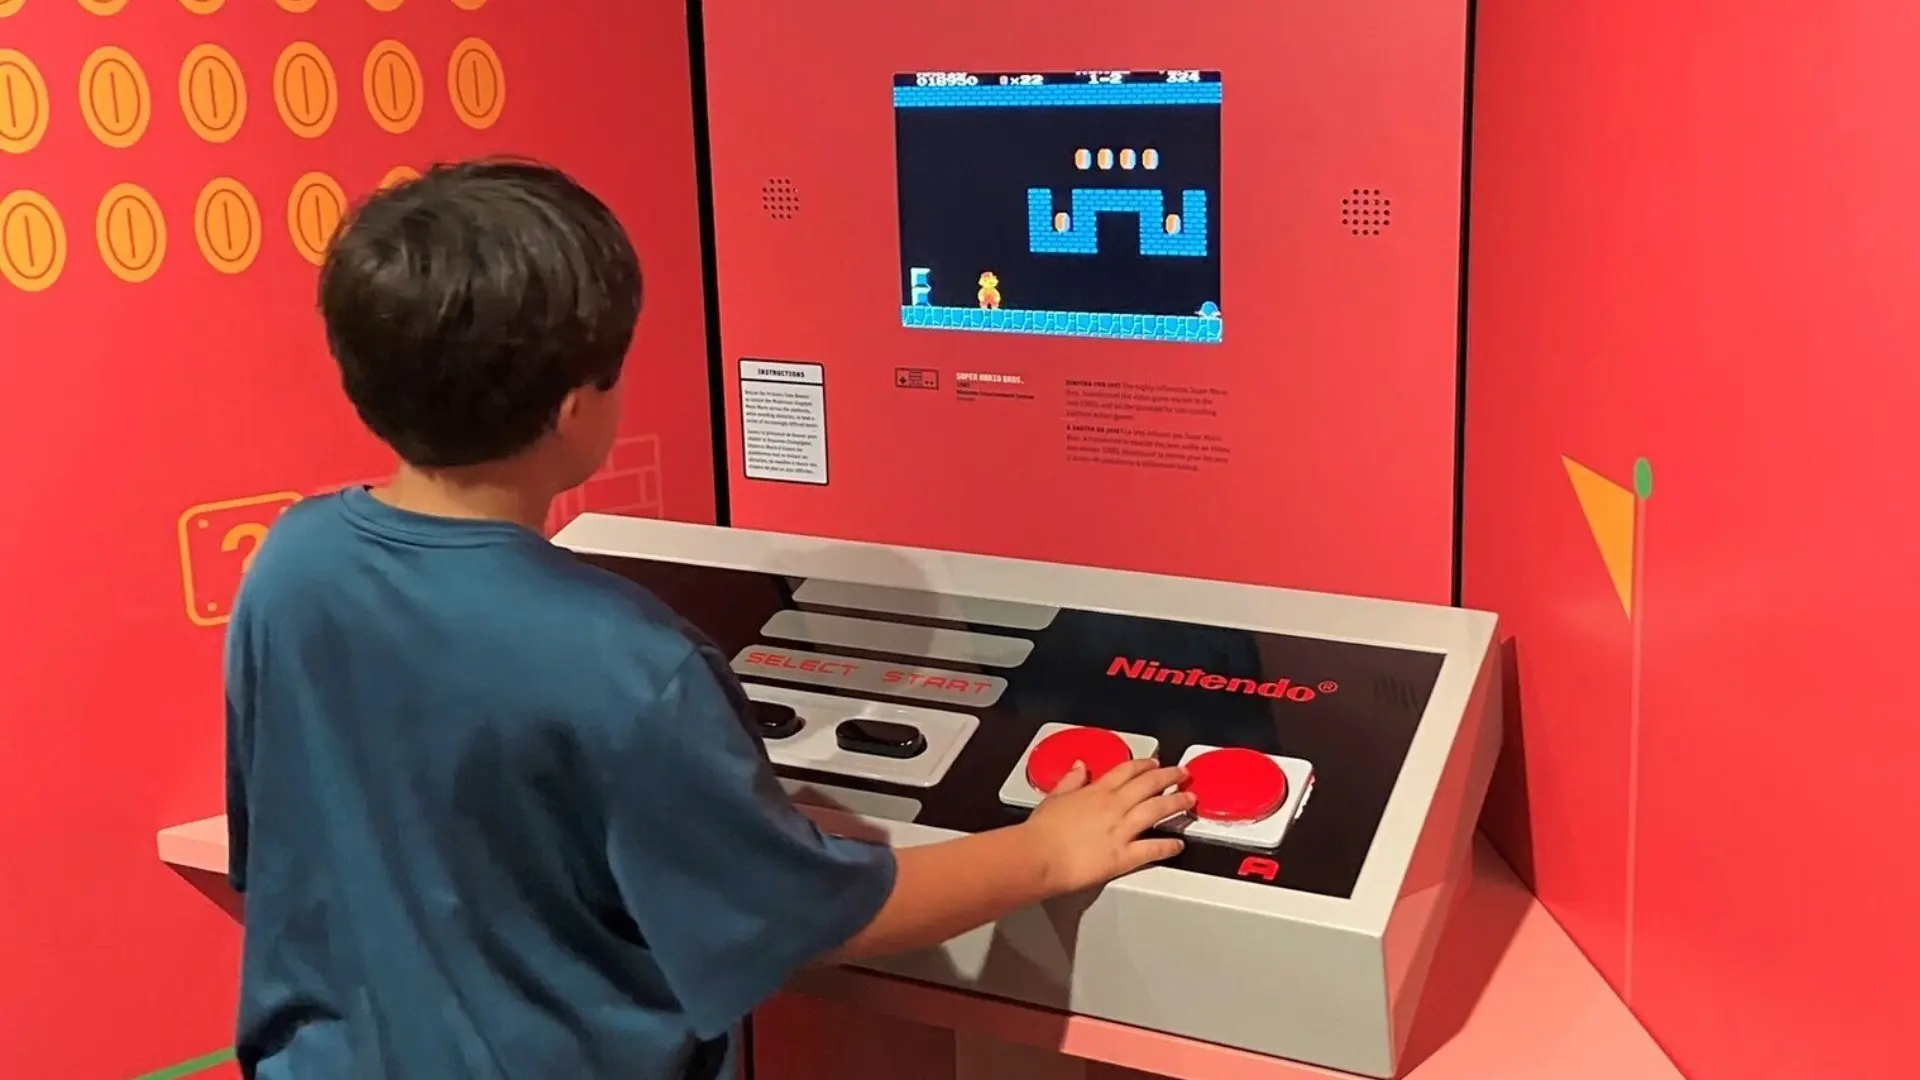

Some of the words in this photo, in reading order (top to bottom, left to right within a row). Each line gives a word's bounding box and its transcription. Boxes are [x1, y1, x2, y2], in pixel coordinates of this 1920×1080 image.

[757, 368, 806, 378] INSTRUCTIONS
[955, 372, 979, 381] SUPER
[745, 651, 859, 677] SELECT
[881, 670, 993, 694] START
[1237, 855, 1280, 881] A
